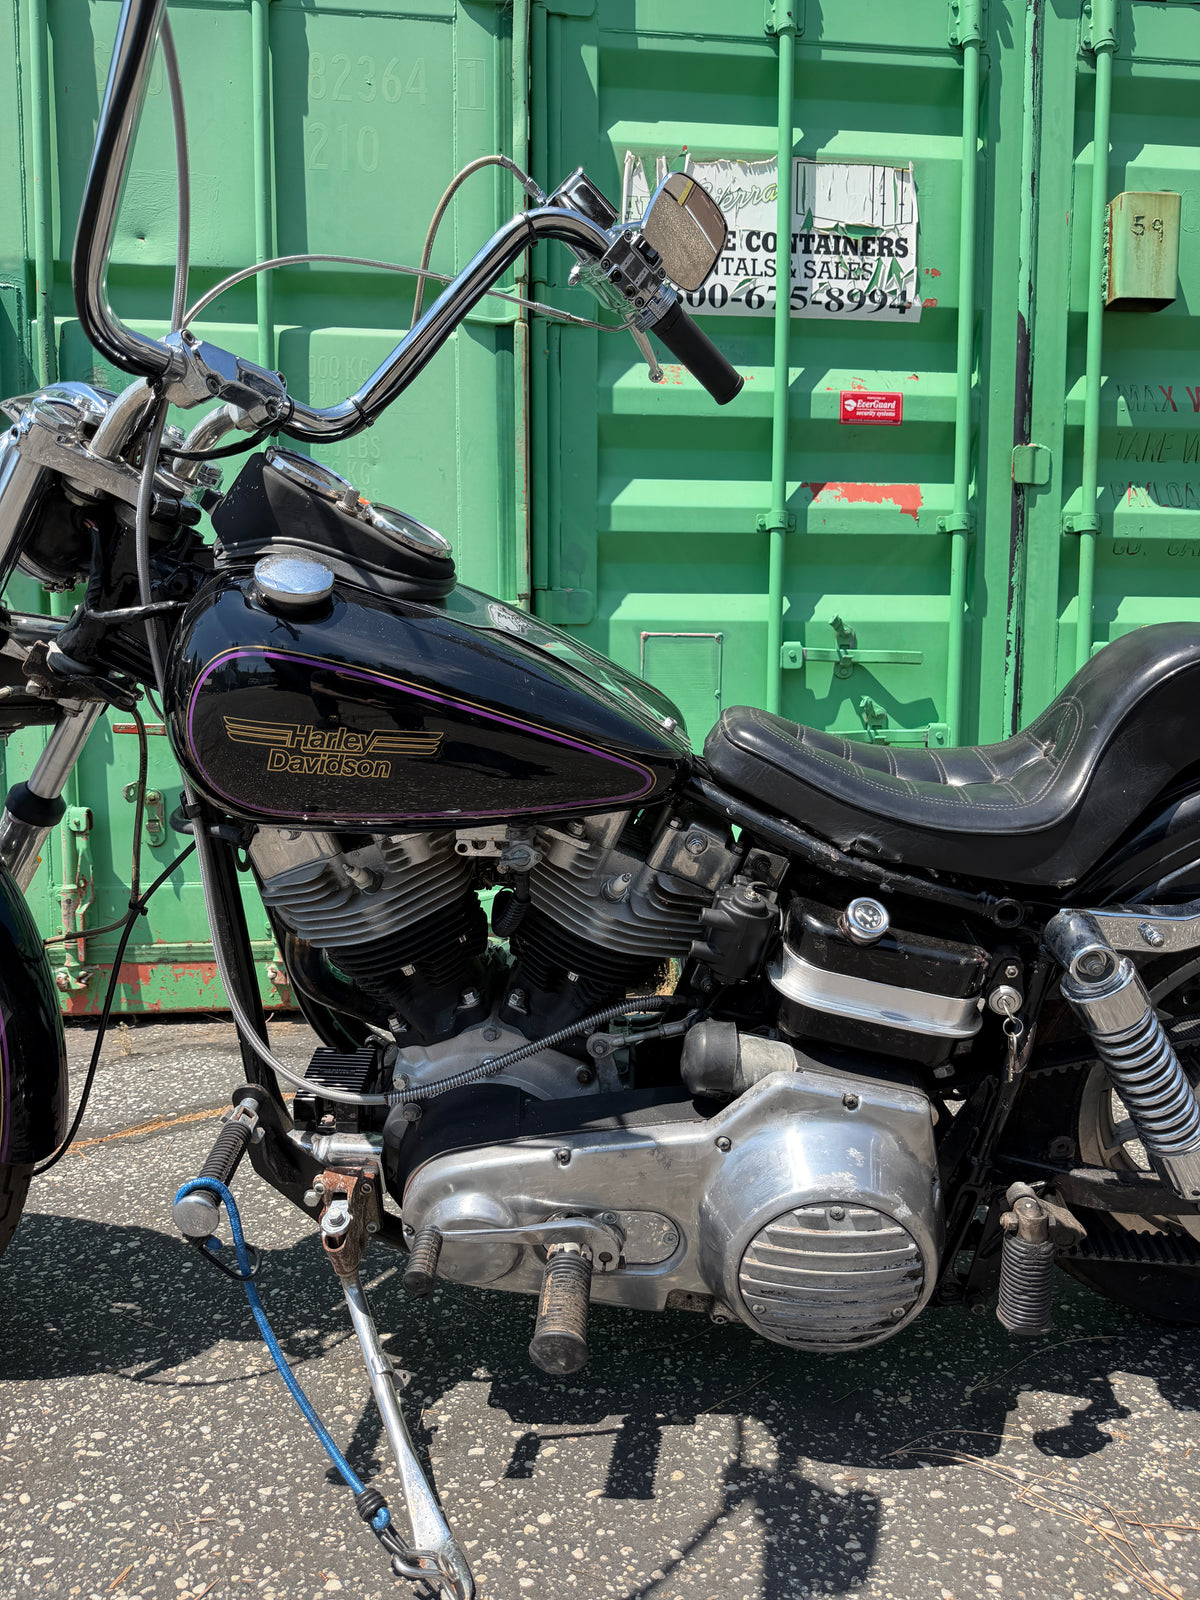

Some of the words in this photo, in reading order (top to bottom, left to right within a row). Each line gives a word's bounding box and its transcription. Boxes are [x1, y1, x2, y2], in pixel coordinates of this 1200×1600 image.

[309, 52, 428, 106] 82364
[307, 122, 380, 174] 210
[700, 180, 777, 213] ierra
[714, 257, 777, 277] TALS
[804, 260, 873, 281] SALES
[676, 283, 912, 315] 00-675-8994
[857, 399, 896, 409] EverGuard
[1116, 384, 1178, 412] MAX
[288, 725, 376, 756] Harley
[267, 748, 391, 779] Davidson
